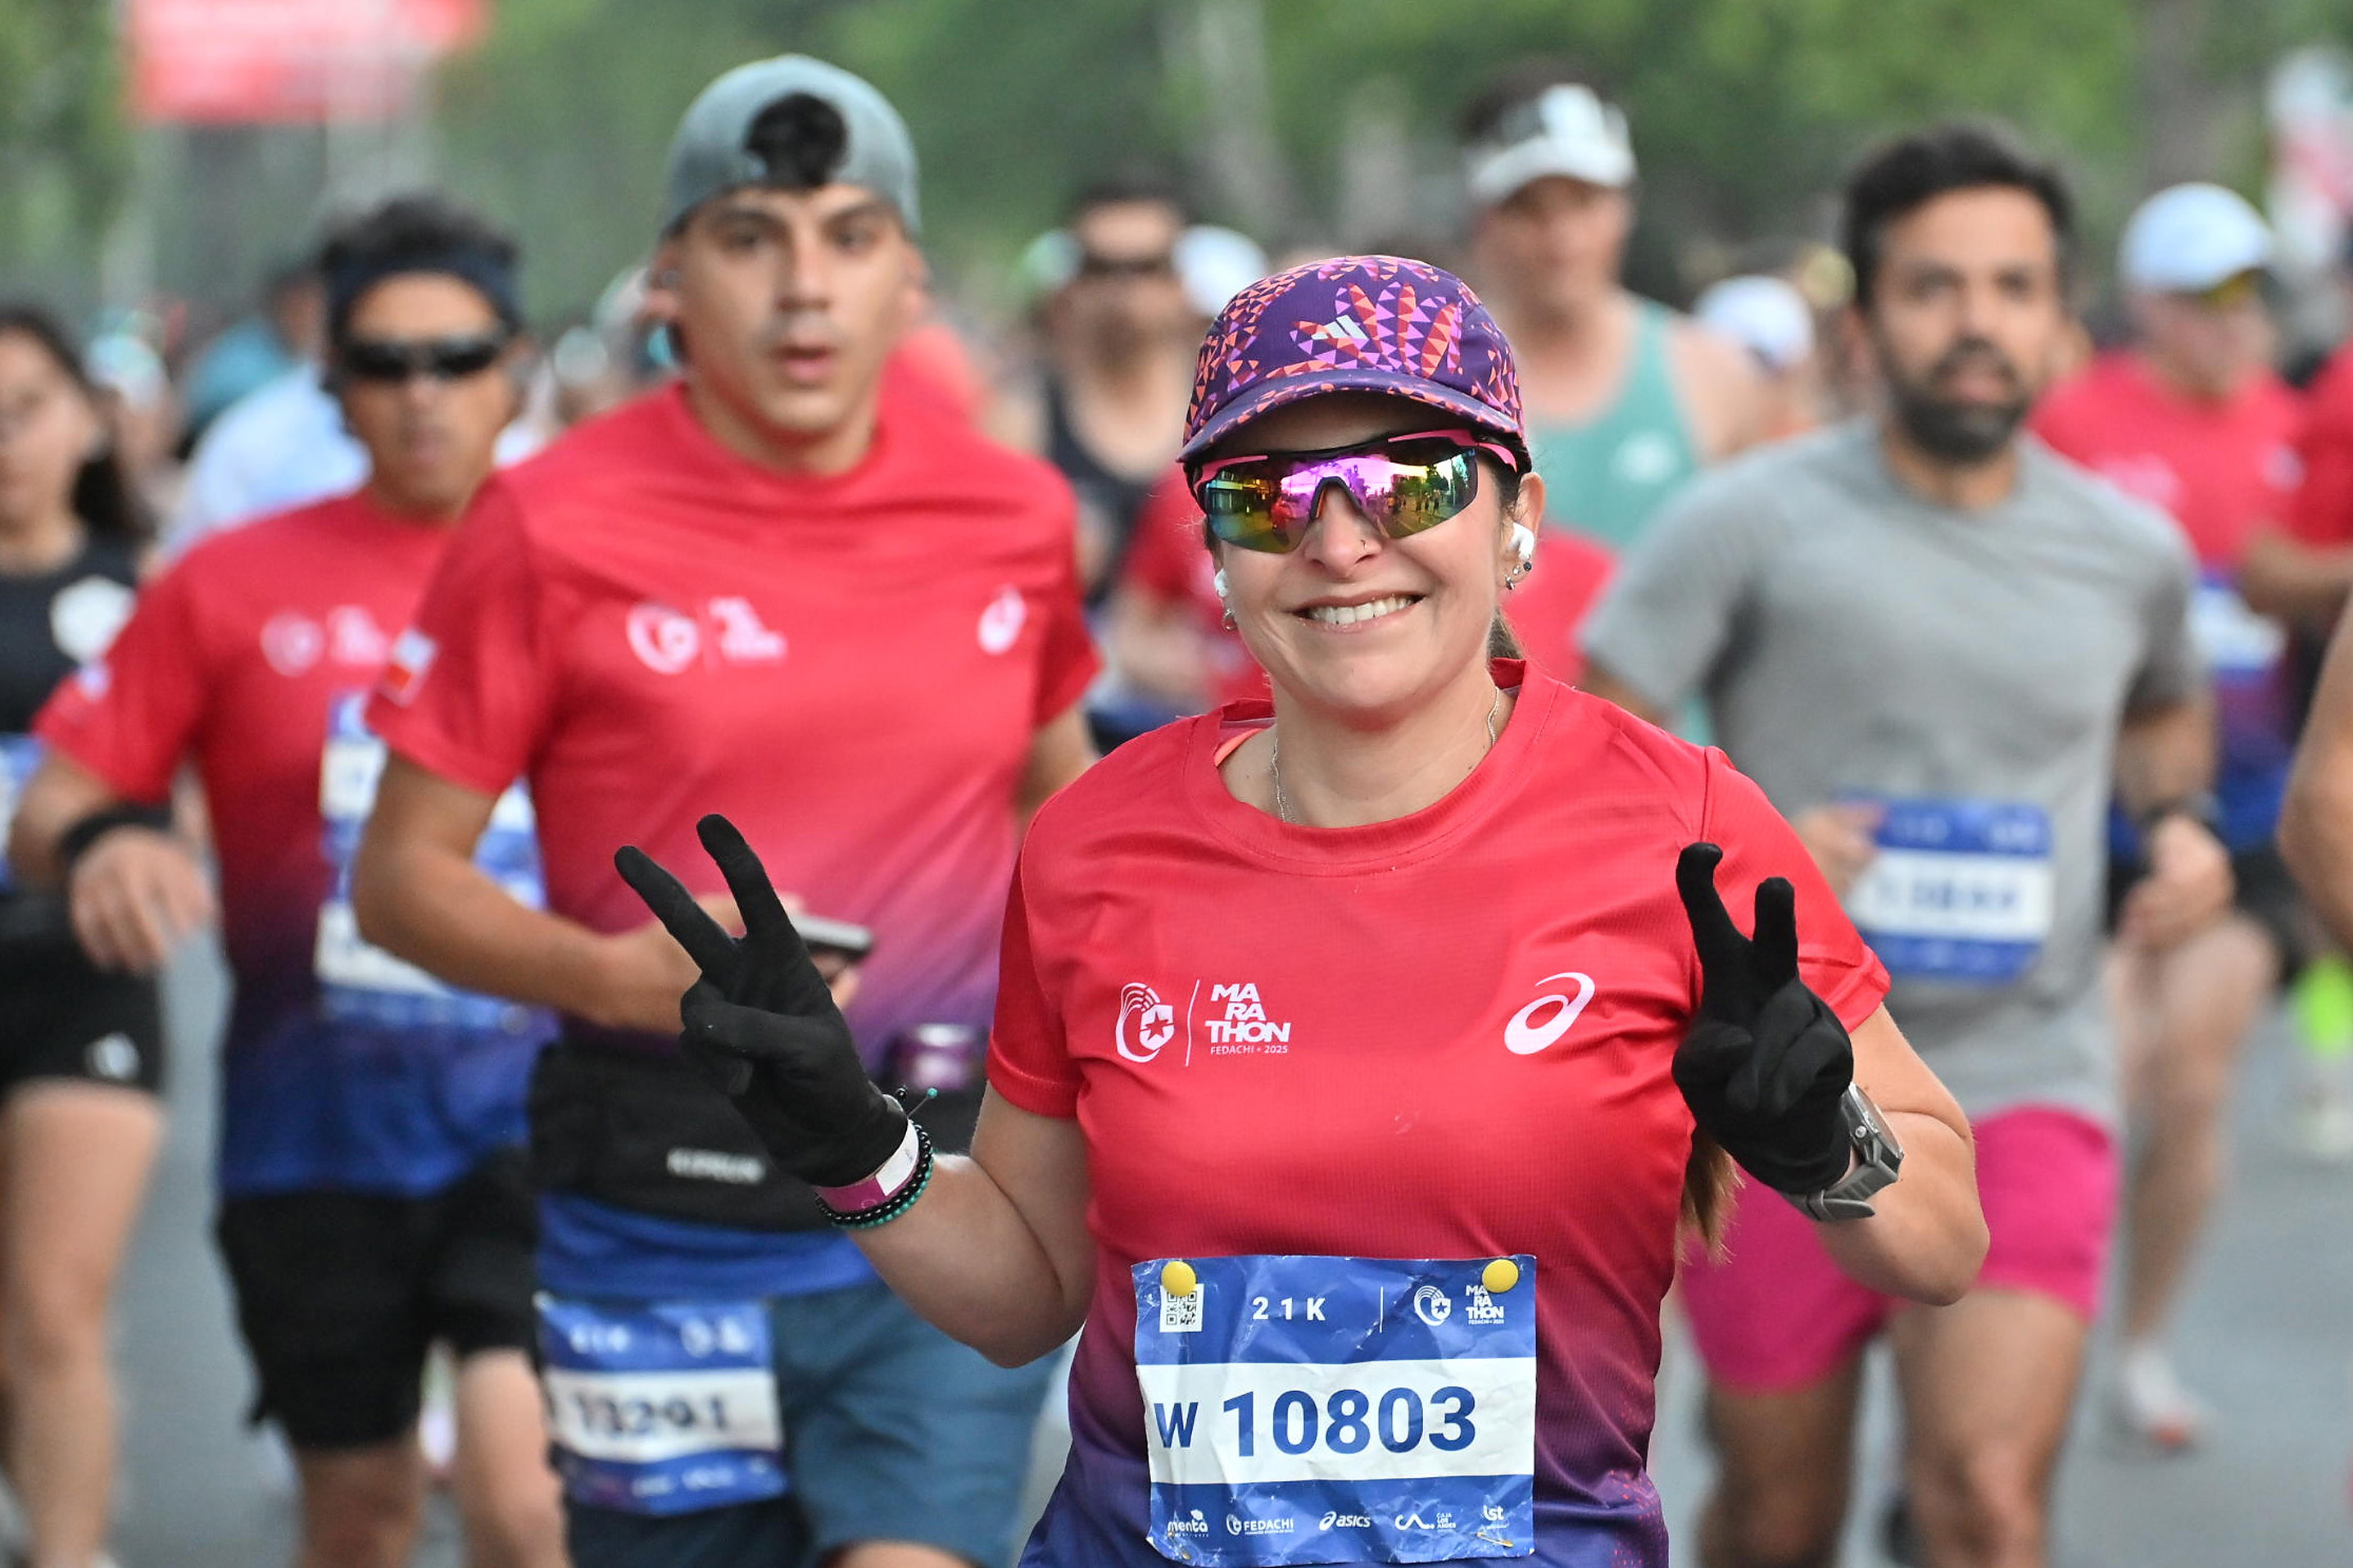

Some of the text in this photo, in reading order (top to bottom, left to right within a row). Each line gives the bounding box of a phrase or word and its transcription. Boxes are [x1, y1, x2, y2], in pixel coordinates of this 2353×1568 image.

[1210, 982, 1260, 1002] MA
[1224, 1002, 1267, 1021] RA
[1204, 1021, 1292, 1044] THON
[1210, 1045, 1289, 1055] FEDACHI 2025
[1465, 1306, 1505, 1320] THON
[1154, 1385, 1476, 1457] W 10803
[1244, 1518, 1294, 1531] FEDACHI
